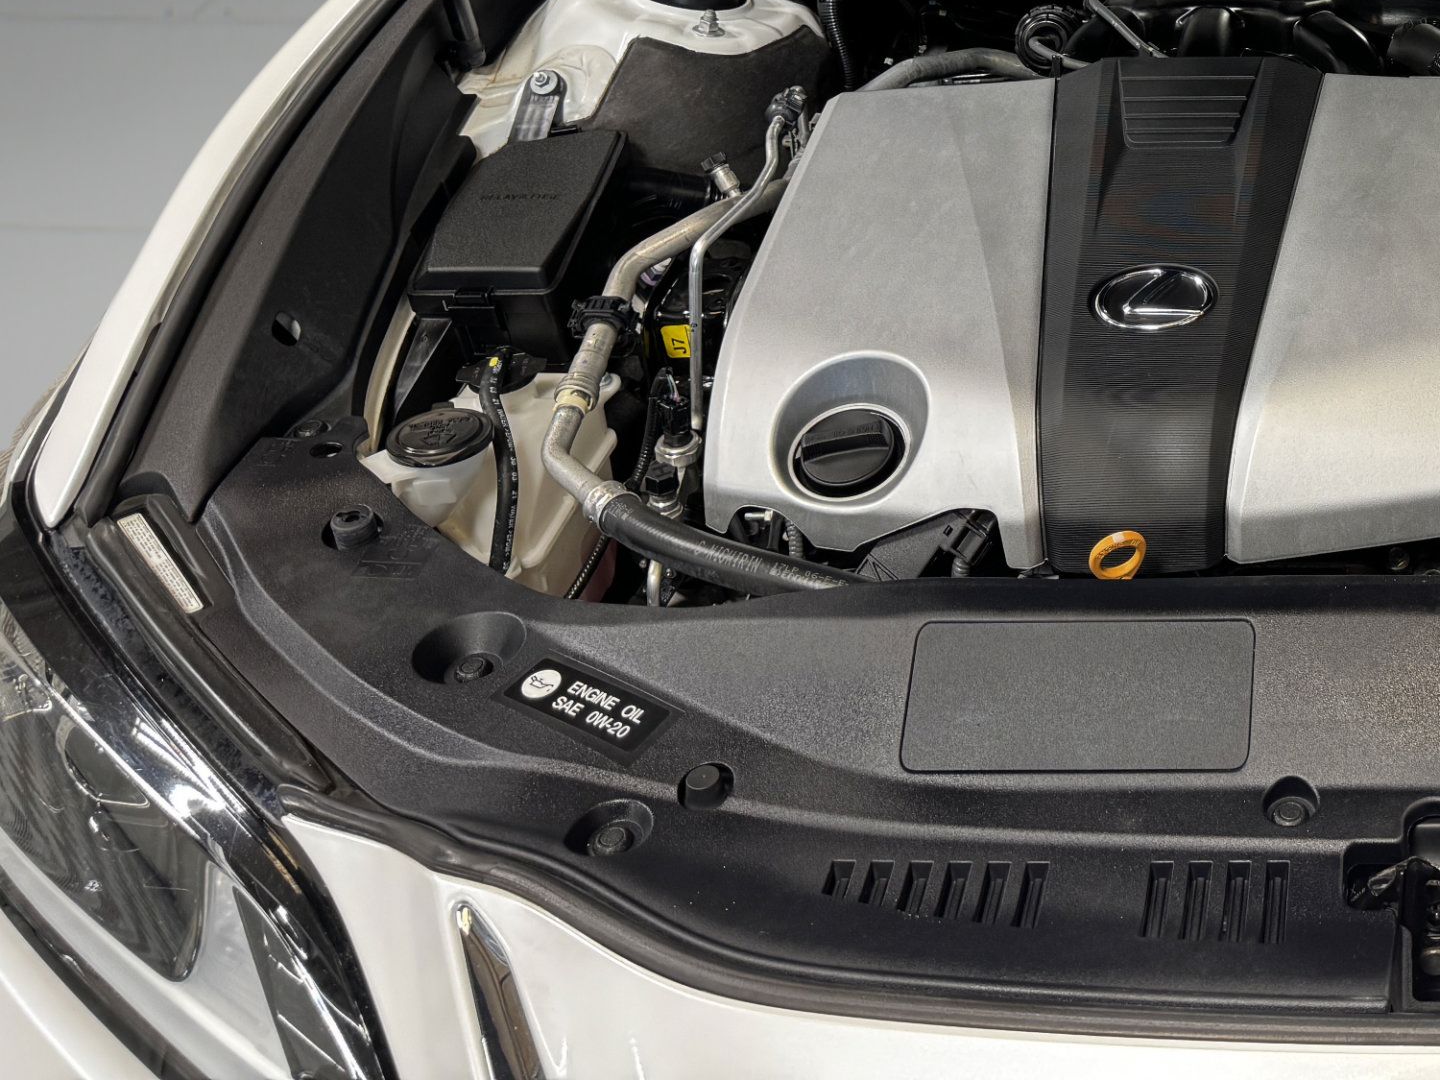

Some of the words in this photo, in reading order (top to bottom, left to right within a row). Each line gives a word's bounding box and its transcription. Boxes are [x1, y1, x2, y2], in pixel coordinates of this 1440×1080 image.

[672, 337, 686, 354] J7
[551, 696, 585, 717] SAE
[585, 710, 631, 739] 0W-20
[566, 680, 620, 711] ENGINE
[620, 705, 645, 724] OIL
